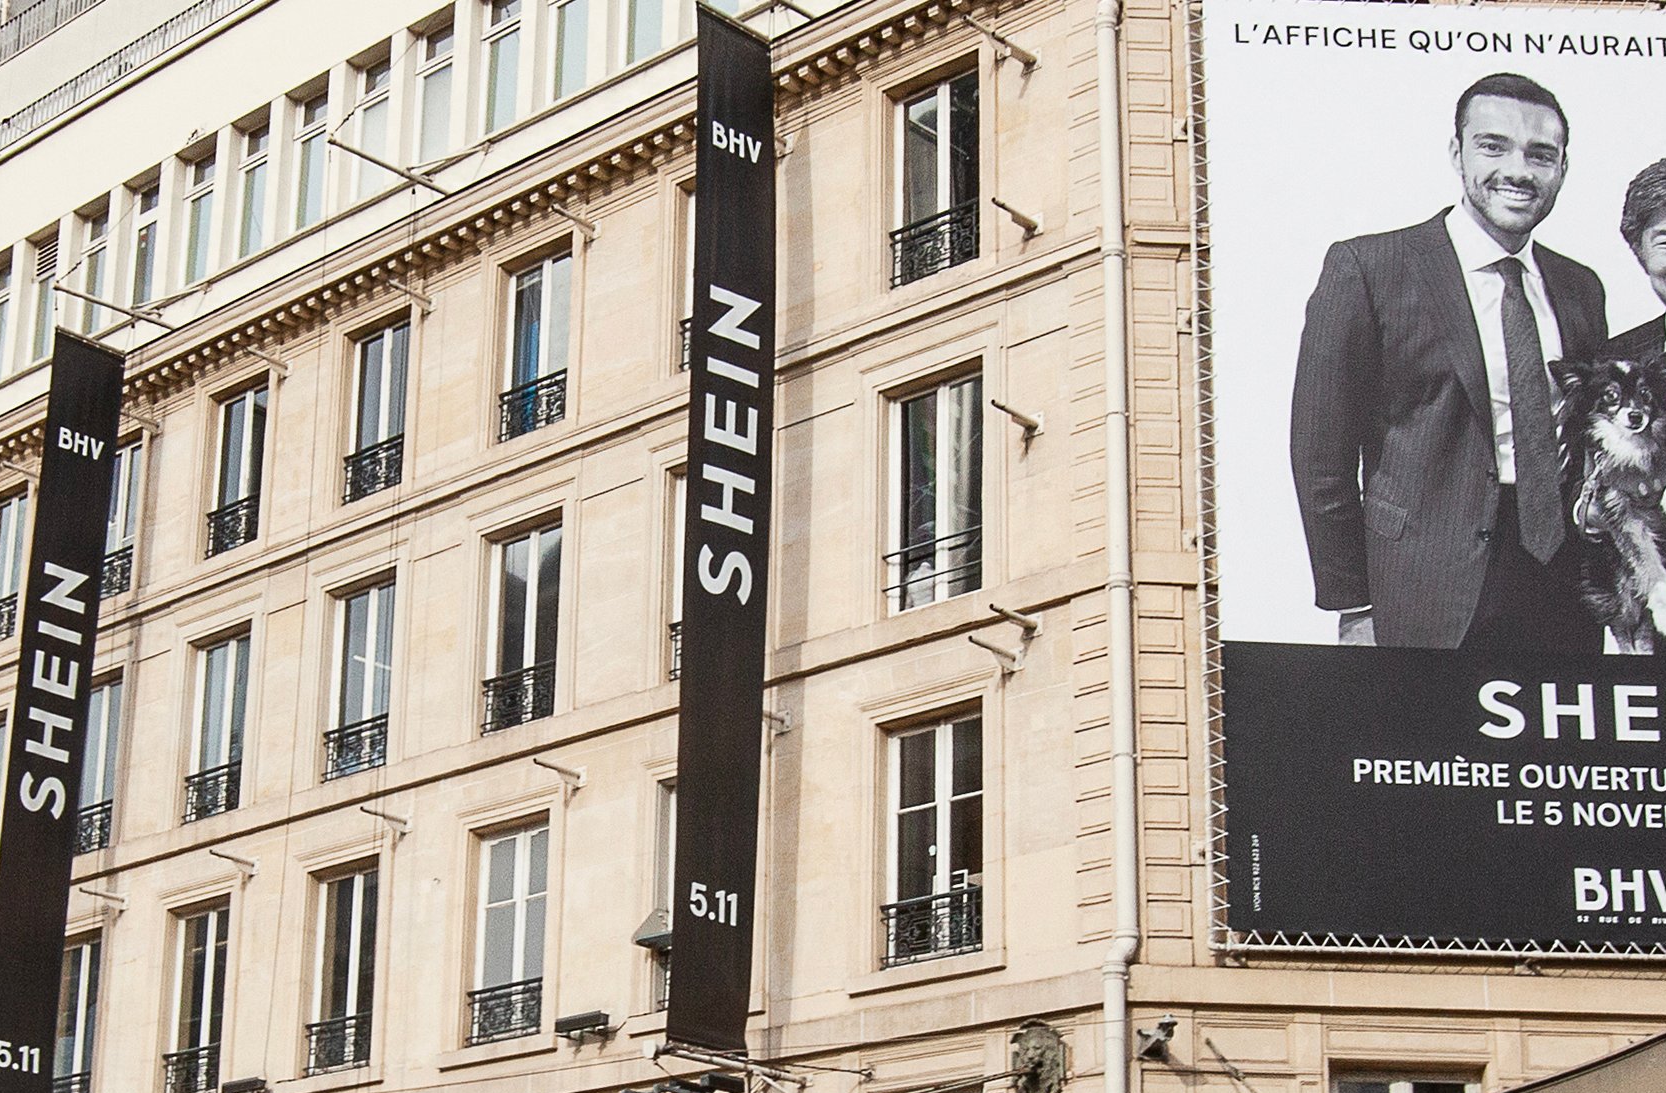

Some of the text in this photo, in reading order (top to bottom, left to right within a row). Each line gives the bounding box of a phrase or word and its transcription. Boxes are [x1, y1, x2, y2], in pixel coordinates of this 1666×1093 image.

[713, 121, 761, 163] BHV
[58, 427, 104, 460] BHV
[698, 284, 761, 605] SHEIN
[20, 562, 89, 819] SHEIN
[1354, 756, 1510, 787] PREMIÈRE
[1497, 800, 1533, 824] LE
[1545, 802, 1562, 825] 5
[690, 882, 737, 926] 5.11
